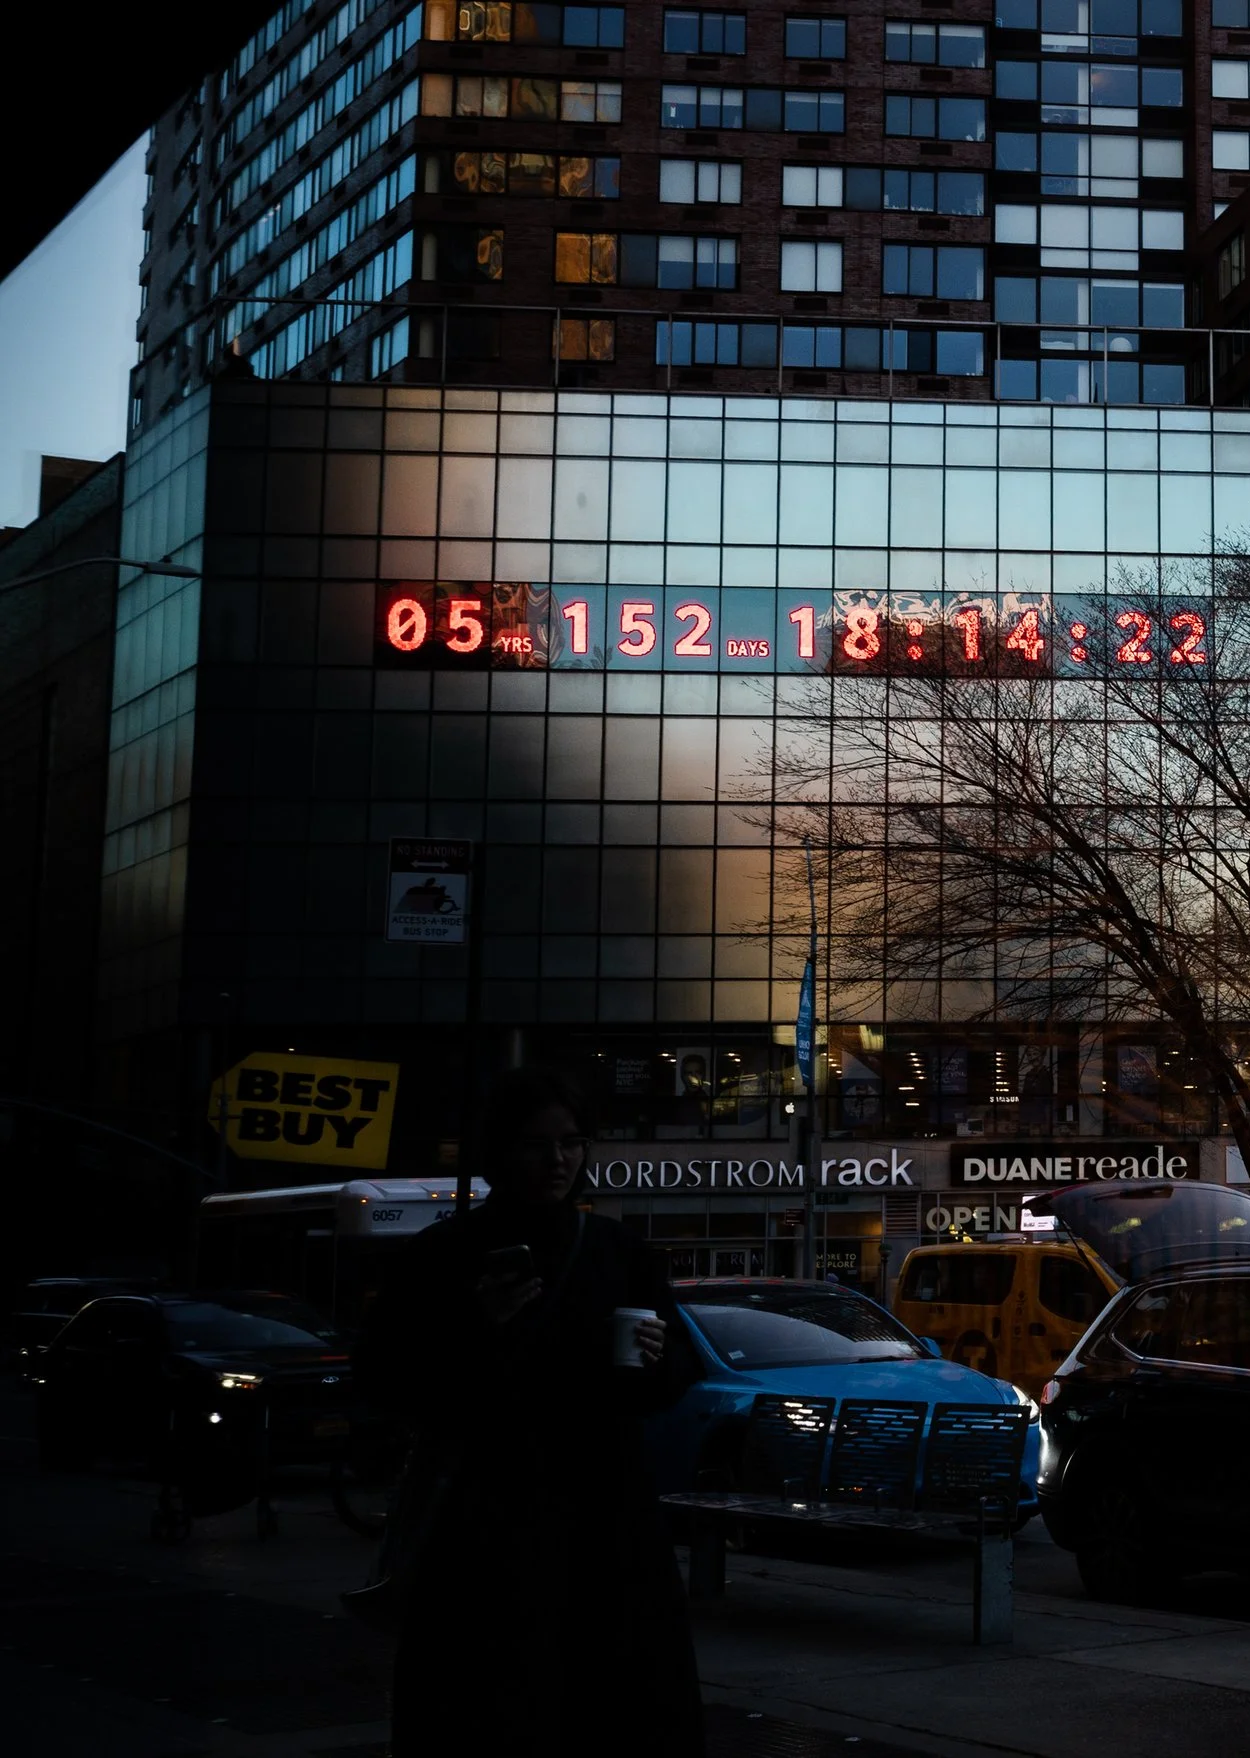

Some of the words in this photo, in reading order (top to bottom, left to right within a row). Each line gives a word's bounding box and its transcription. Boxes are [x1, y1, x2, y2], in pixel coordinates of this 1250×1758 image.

[387, 598, 485, 652] 05
[501, 636, 532, 653] YRS
[562, 601, 712, 658] 152
[727, 640, 770, 657] DAYS
[396, 844, 411, 856] NO
[414, 844, 466, 858] STANDING
[403, 927, 422, 935] BUS
[425, 928, 448, 936] STOP
[238, 1068, 390, 1112] BEST
[238, 1107, 373, 1148] BUY
[585, 1159, 804, 1187] NORDSTROM
[821, 1148, 914, 1186] rack
[964, 1157, 1073, 1181] DUANE
[1075, 1145, 1188, 1180] reade
[372, 1209, 403, 1222] 6057
[926, 1206, 1016, 1232] OPEN
[844, 1252, 857, 1261] TO
